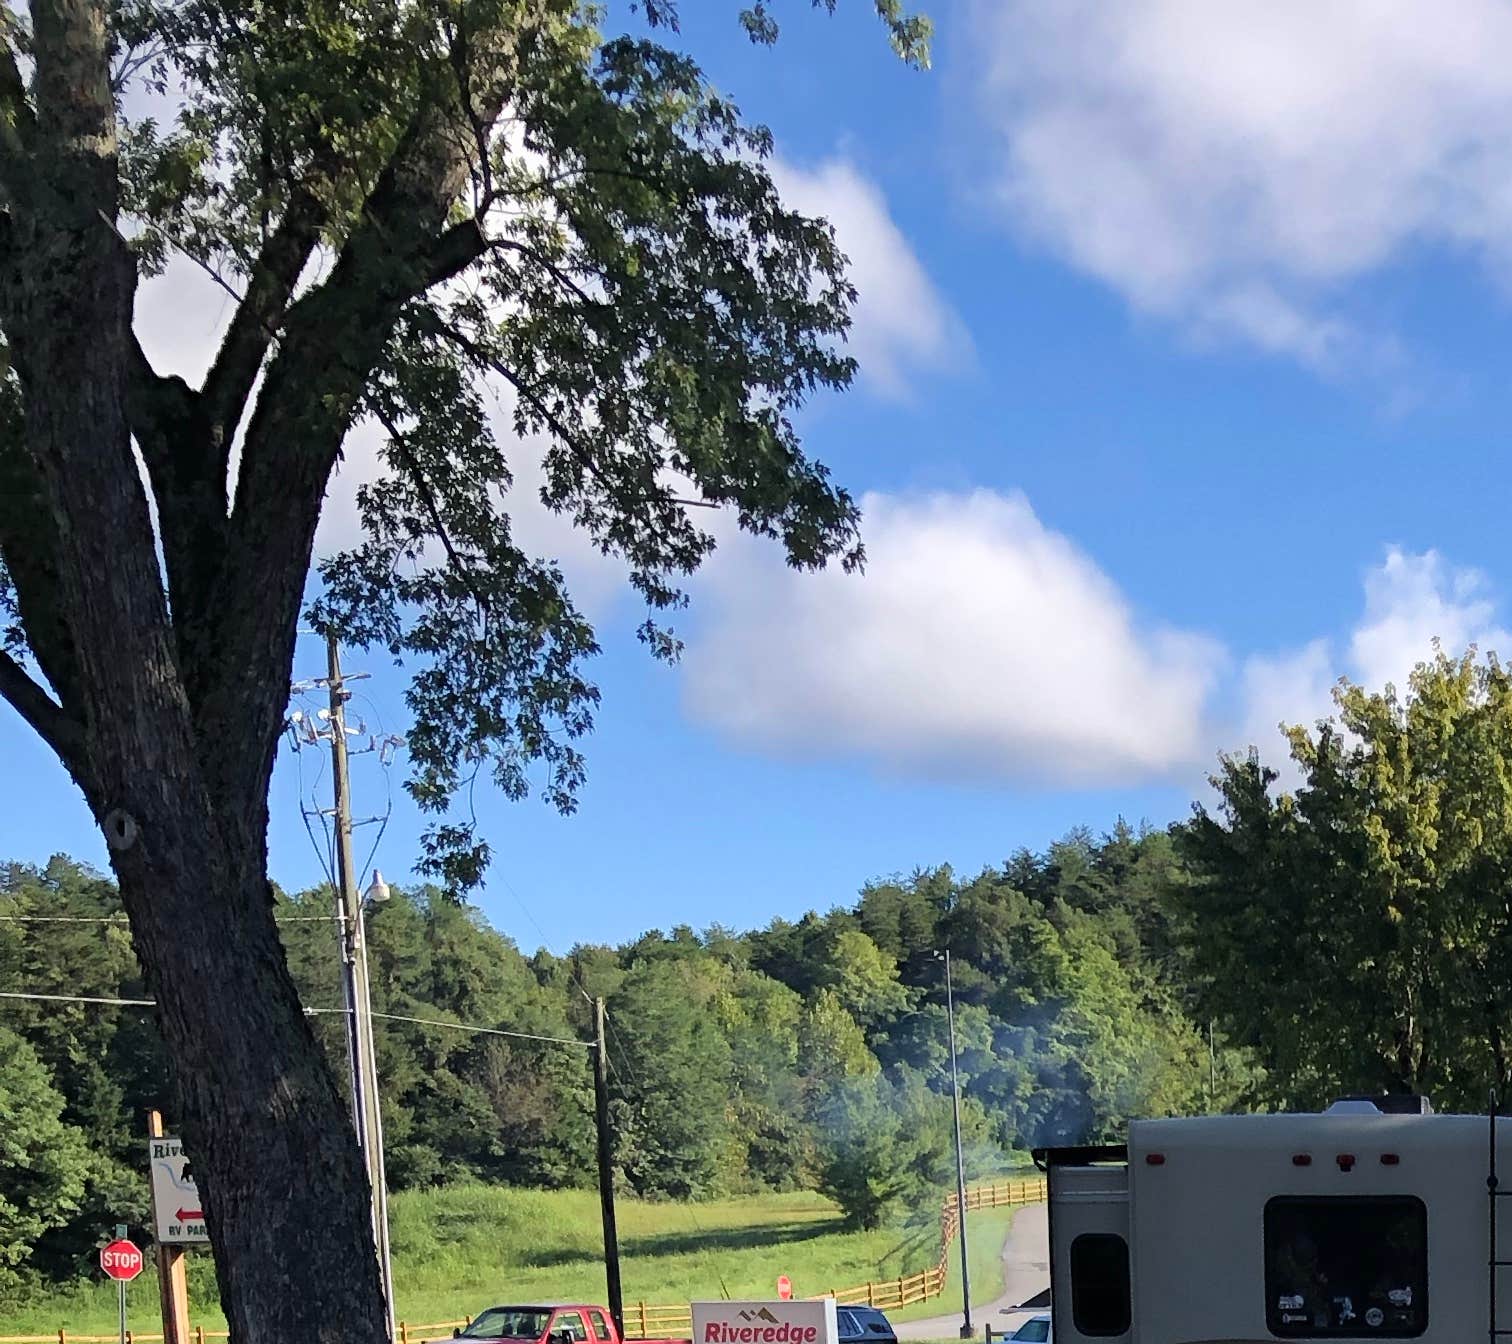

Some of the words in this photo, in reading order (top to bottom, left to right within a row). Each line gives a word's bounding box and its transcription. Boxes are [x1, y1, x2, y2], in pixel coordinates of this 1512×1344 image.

[169, 1225, 181, 1236] RV
[187, 1225, 209, 1236] PAR
[104, 1252, 139, 1268] STOP
